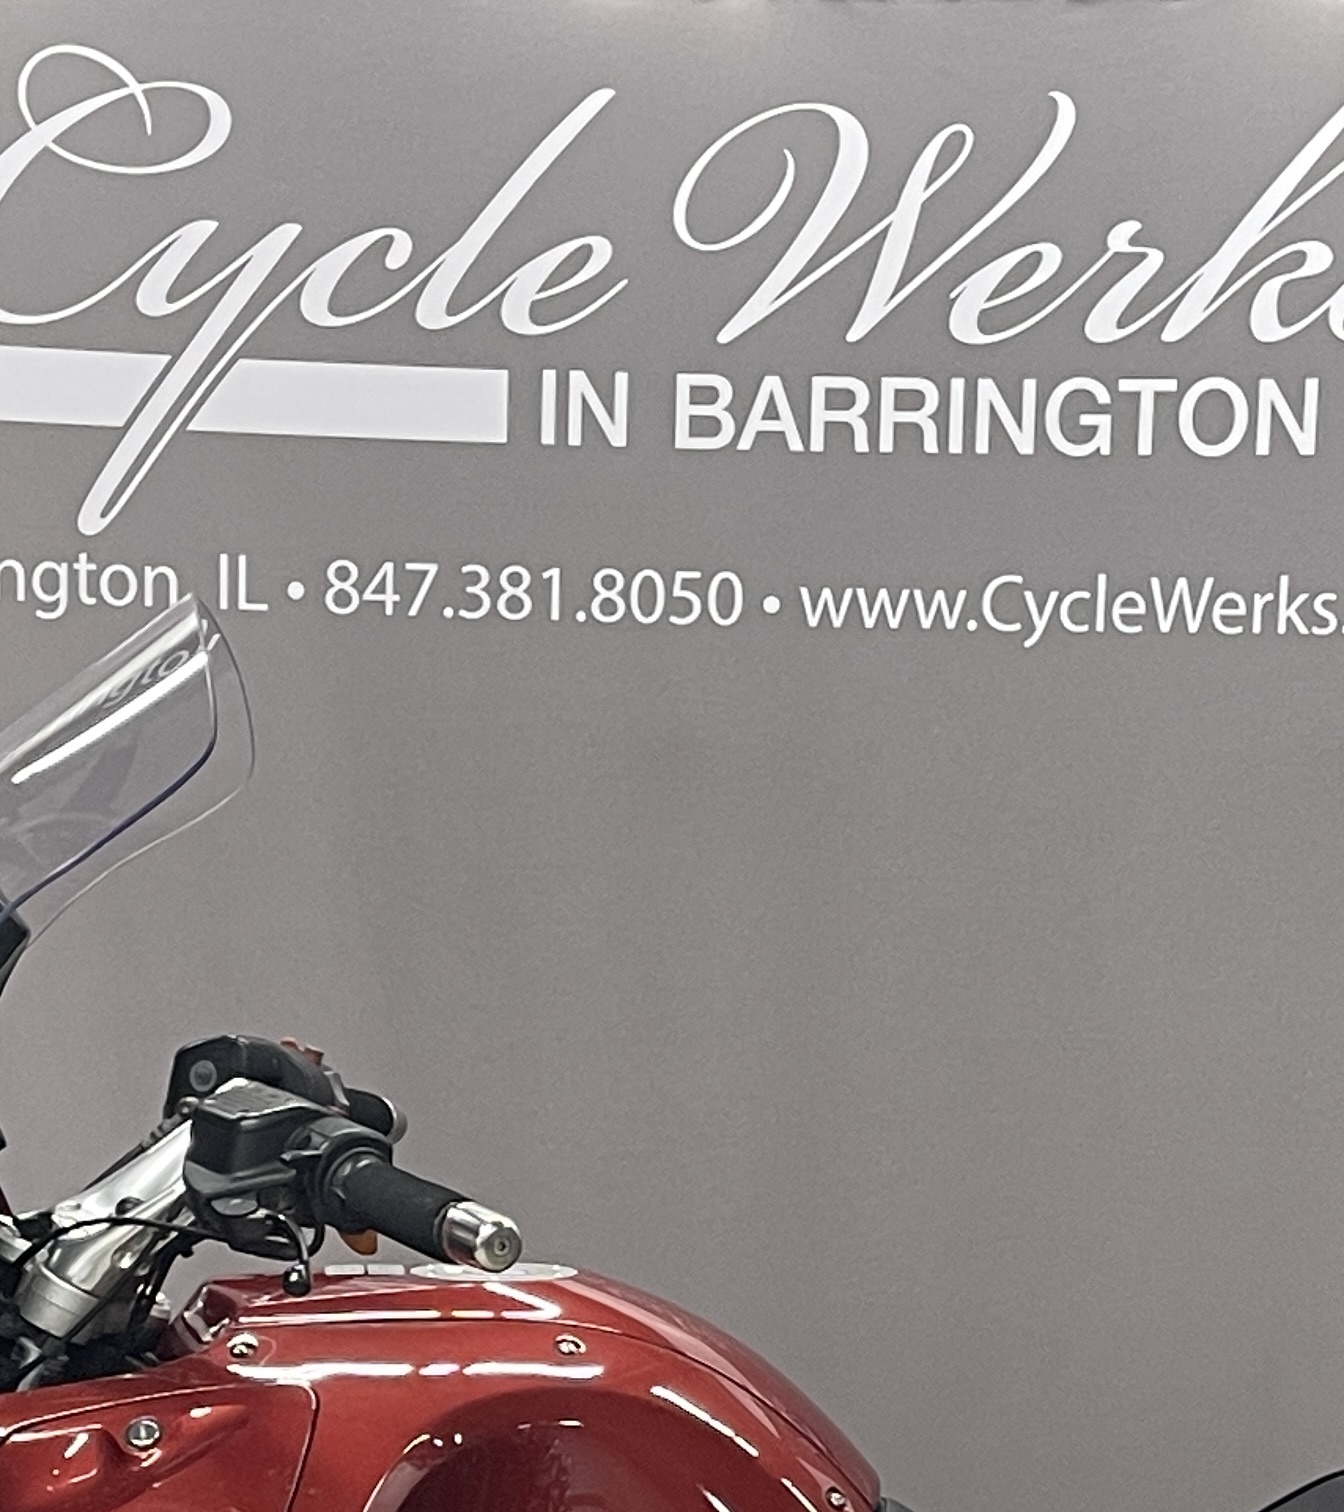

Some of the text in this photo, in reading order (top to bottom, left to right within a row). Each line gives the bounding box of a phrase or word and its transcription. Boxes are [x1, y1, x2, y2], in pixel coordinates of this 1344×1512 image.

[540, 369, 1321, 458] IN BARRINGTON
[218, 552, 270, 613] IL
[324, 558, 746, 628] 847.381.8050
